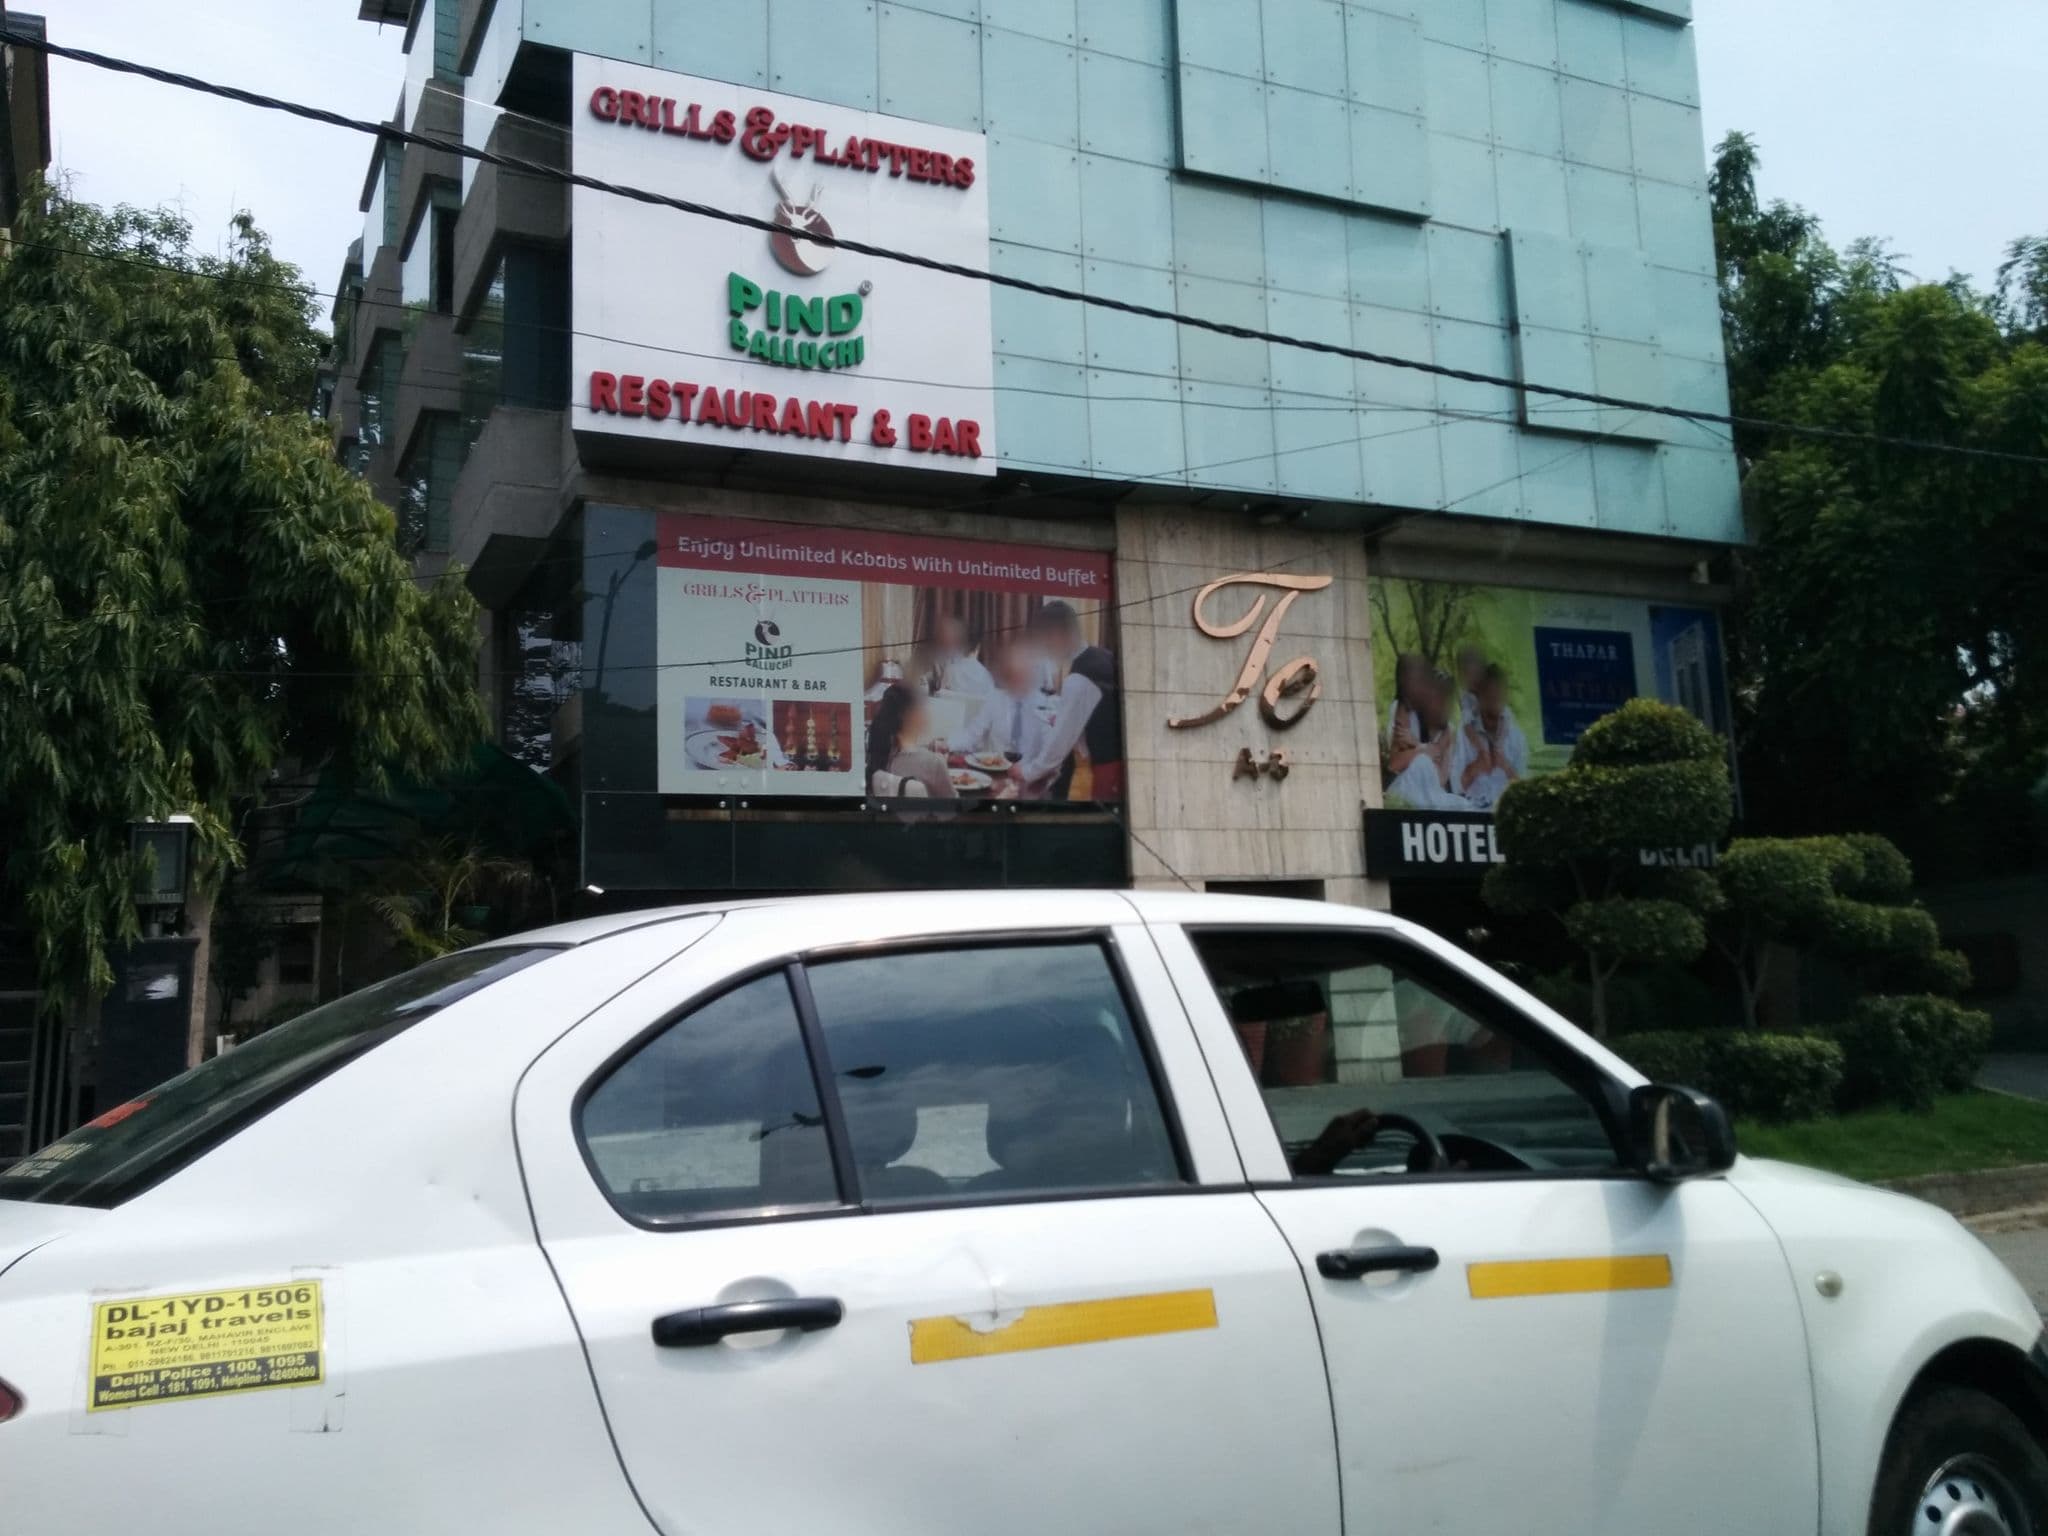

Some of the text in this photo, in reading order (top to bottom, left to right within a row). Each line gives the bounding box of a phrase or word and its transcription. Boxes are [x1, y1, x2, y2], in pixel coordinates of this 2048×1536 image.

[590, 86, 736, 144] GRILLS
[790, 124, 976, 190] PLATTERS
[728, 272, 863, 336] PIND
[729, 318, 864, 370] BALLUCHI
[590, 370, 982, 458] RESTAURANT & BAR
[678, 535, 1097, 588] Enjoy Unlimited Kebabs With Unlimited Buffet
[684, 583, 743, 598] GRILLS
[769, 588, 849, 606] PLATTERS
[745, 642, 793, 660] PIND
[1549, 641, 1620, 661] THAPAR
[710, 676, 828, 691] RESTAURANT & BAR
[1401, 822, 1506, 863] HOTEL
[106, 1308, 312, 1340] bajaj travels
[107, 1288, 312, 1324] DL-1YD-1506
[111, 1369, 155, 1387] Delhi
[160, 1363, 211, 1380] Police
[227, 1360, 262, 1375] 100,
[267, 1355, 306, 1369] 1095
